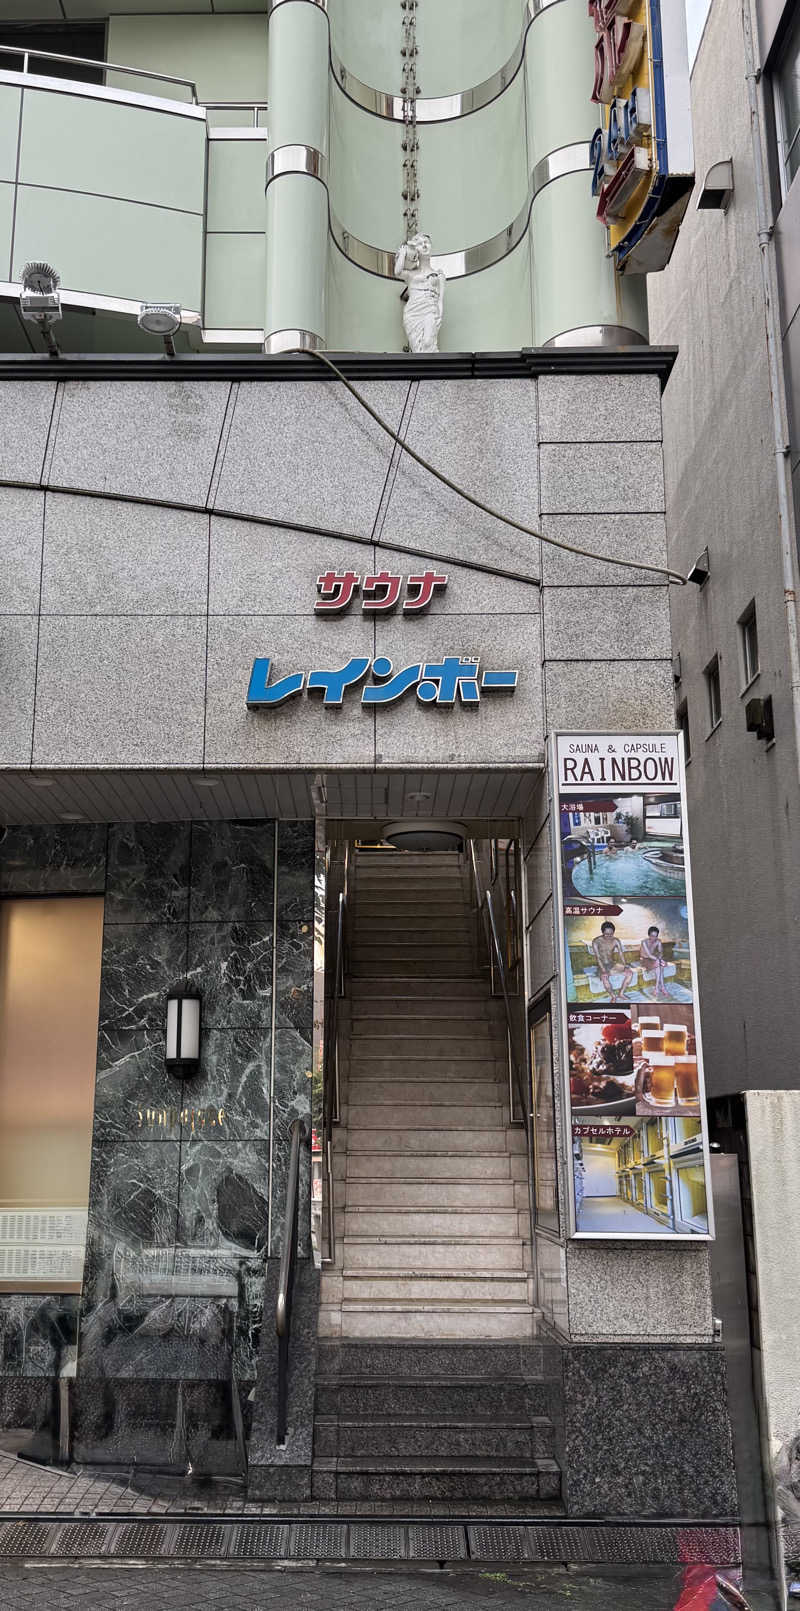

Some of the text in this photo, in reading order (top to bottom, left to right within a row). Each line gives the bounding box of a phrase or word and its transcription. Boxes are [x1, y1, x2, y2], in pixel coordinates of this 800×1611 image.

[314, 571, 448, 609] サウナ
[246, 656, 518, 703] レインボー
[568, 743, 667, 754] SAUNA & CAPSULE
[563, 757, 675, 782] RAINBOW
[560, 803, 584, 811] 大浴場
[565, 906, 604, 915] 高温サウナ
[569, 1014, 617, 1023] 飲食コーナー
